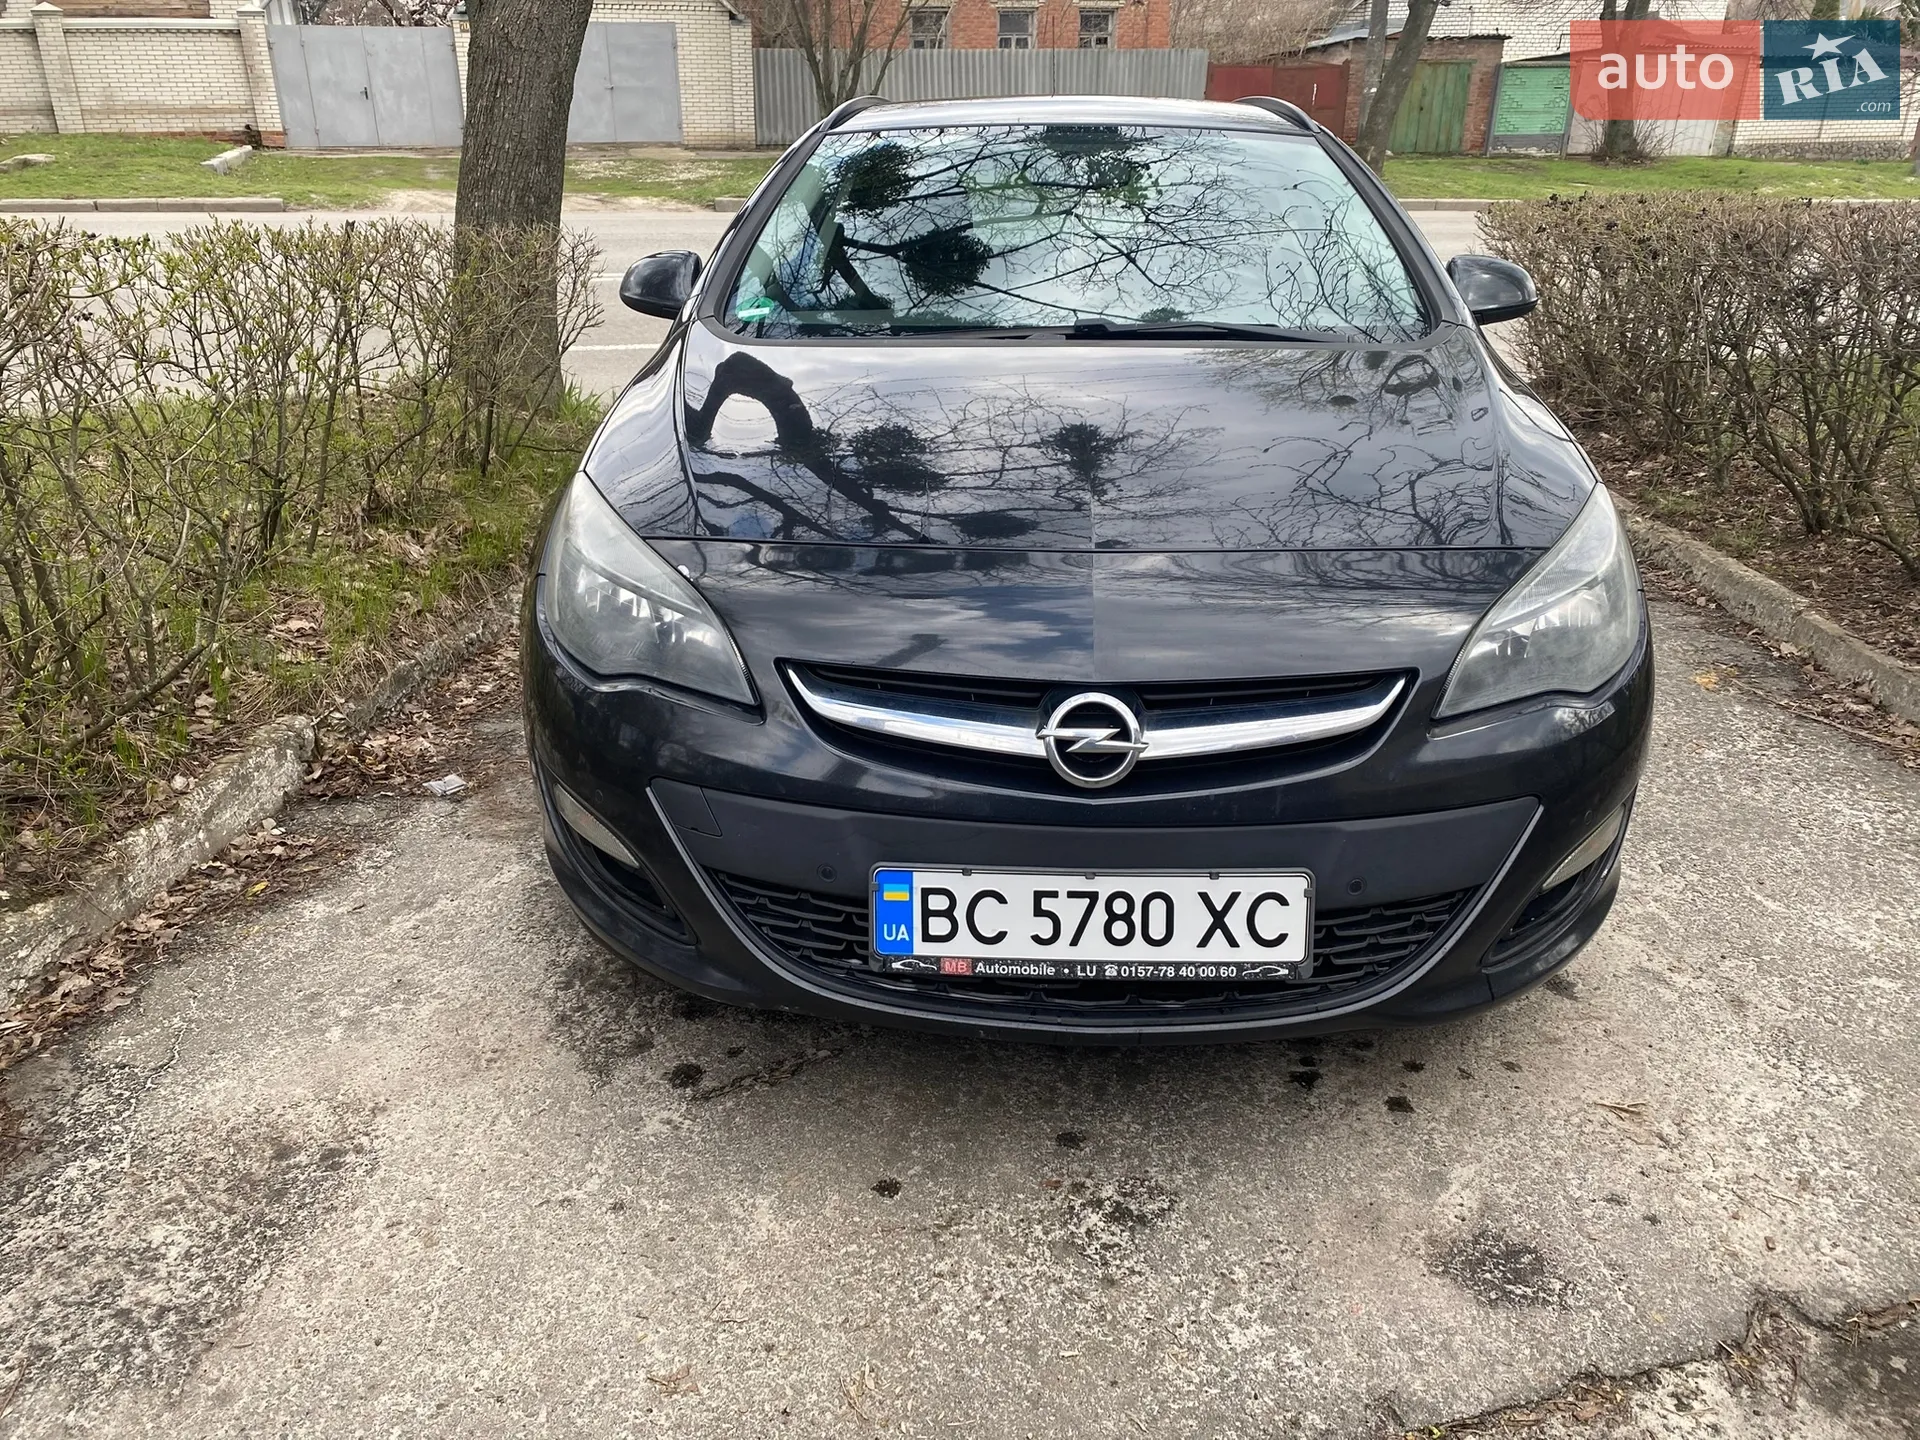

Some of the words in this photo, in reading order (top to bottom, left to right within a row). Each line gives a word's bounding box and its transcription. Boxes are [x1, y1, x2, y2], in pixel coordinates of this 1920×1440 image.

[921, 888, 1008, 945] BC
[1030, 890, 1174, 947] 5780
[1196, 891, 1290, 948] XC
[884, 924, 909, 940] UA
[944, 961, 967, 973] MB
[975, 962, 1055, 976] Automobile
[1077, 965, 1097, 977] LU
